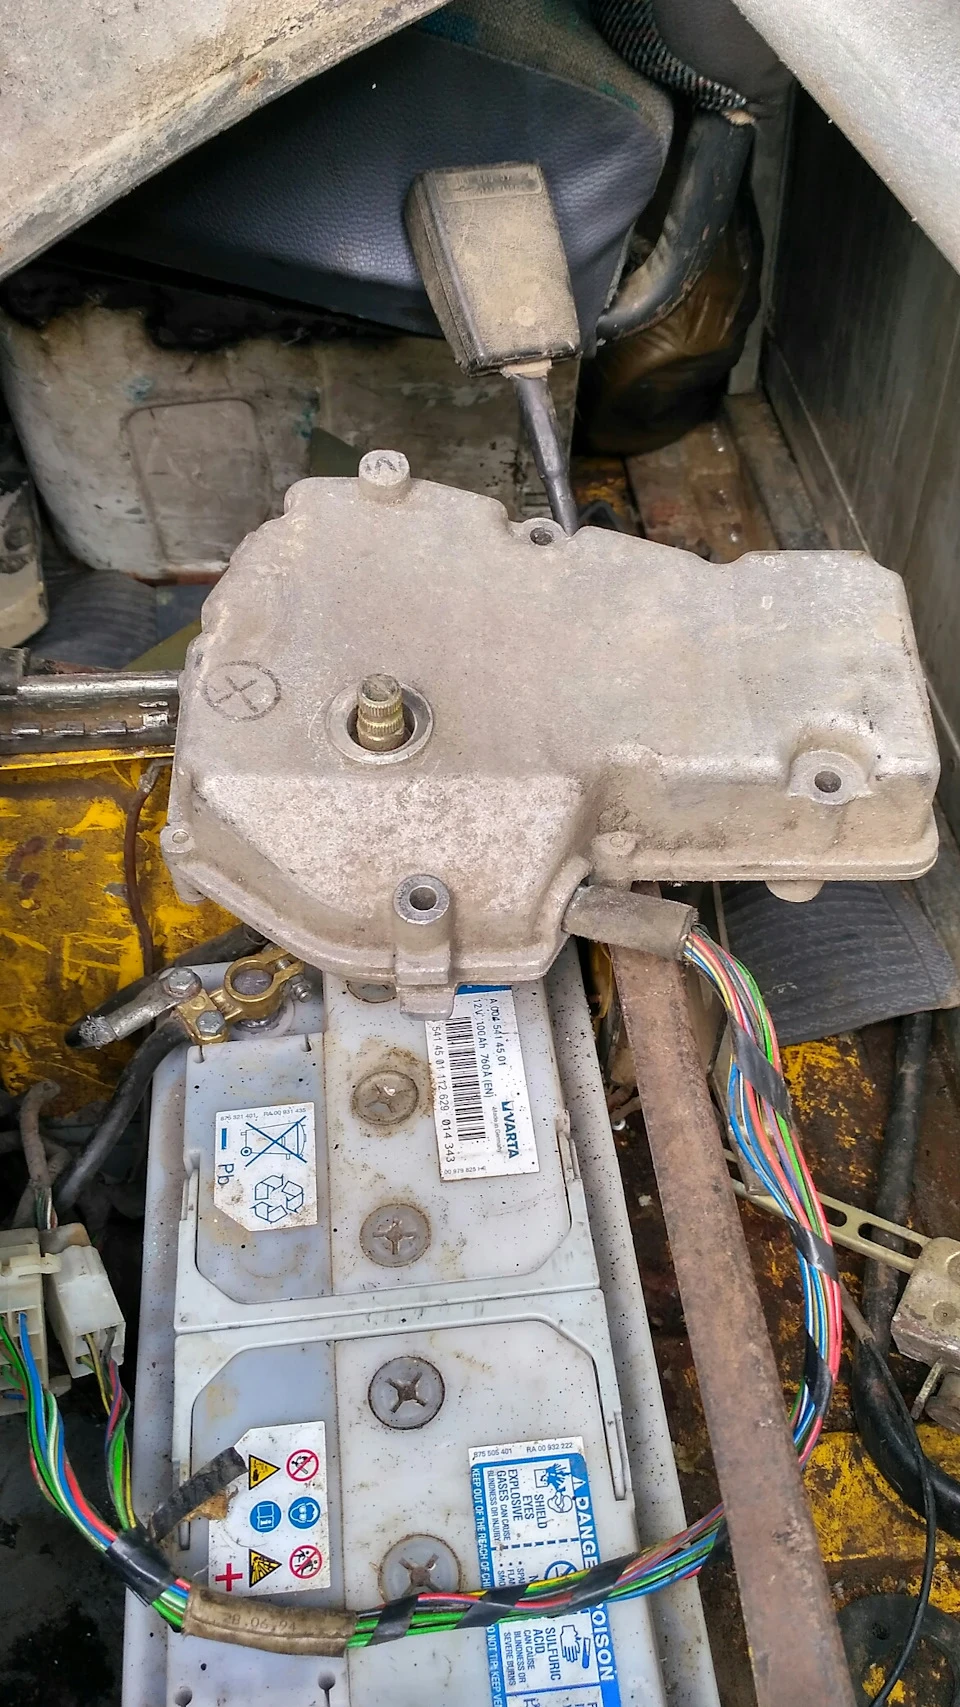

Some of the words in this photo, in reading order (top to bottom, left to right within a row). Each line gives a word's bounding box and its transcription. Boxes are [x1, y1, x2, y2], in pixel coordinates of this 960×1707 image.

[493, 1024, 502, 1039] 541
[434, 1045, 444, 1056] 45
[496, 1042, 505, 1053] 45
[497, 1056, 506, 1066] 01
[482, 1080, 495, 1098] (EN)
[439, 1094, 449, 1111] 629
[442, 1119, 452, 1139] 014
[503, 1112, 519, 1159] VARTA
[494, 1129, 503, 1153] Germany
[445, 1143, 455, 1163] 343
[217, 1163, 234, 1185] Pb
[472, 1468, 482, 1486] KEEP
[487, 1470, 498, 1506] BLINDNESS
[497, 1470, 509, 1501] GASES
[473, 1488, 483, 1505] OUT
[508, 1469, 523, 1521] EXPLOSIVE
[522, 1495, 534, 1520] EYES
[534, 1494, 547, 1529] SHIELD
[476, 1517, 485, 1532] THE
[492, 1518, 502, 1541] INJURY
[501, 1519, 511, 1541] CAUSE
[576, 1496, 598, 1569] DANGE
[478, 1533, 488, 1559] REACH
[480, 1561, 489, 1571] OF
[487, 1634, 497, 1652] NOT
[504, 1632, 513, 1660] SEVERE
[523, 1629, 533, 1644] CAN
[533, 1629, 545, 1654] ACID
[514, 1631, 525, 1671] BLINDNESS
[525, 1645, 535, 1670] CAUSE
[545, 1627, 561, 1681] SULFURIC
[490, 1671, 502, 1692] KEEP
[507, 1660, 516, 1686] BURNS
[517, 1672, 526, 1683] OR
